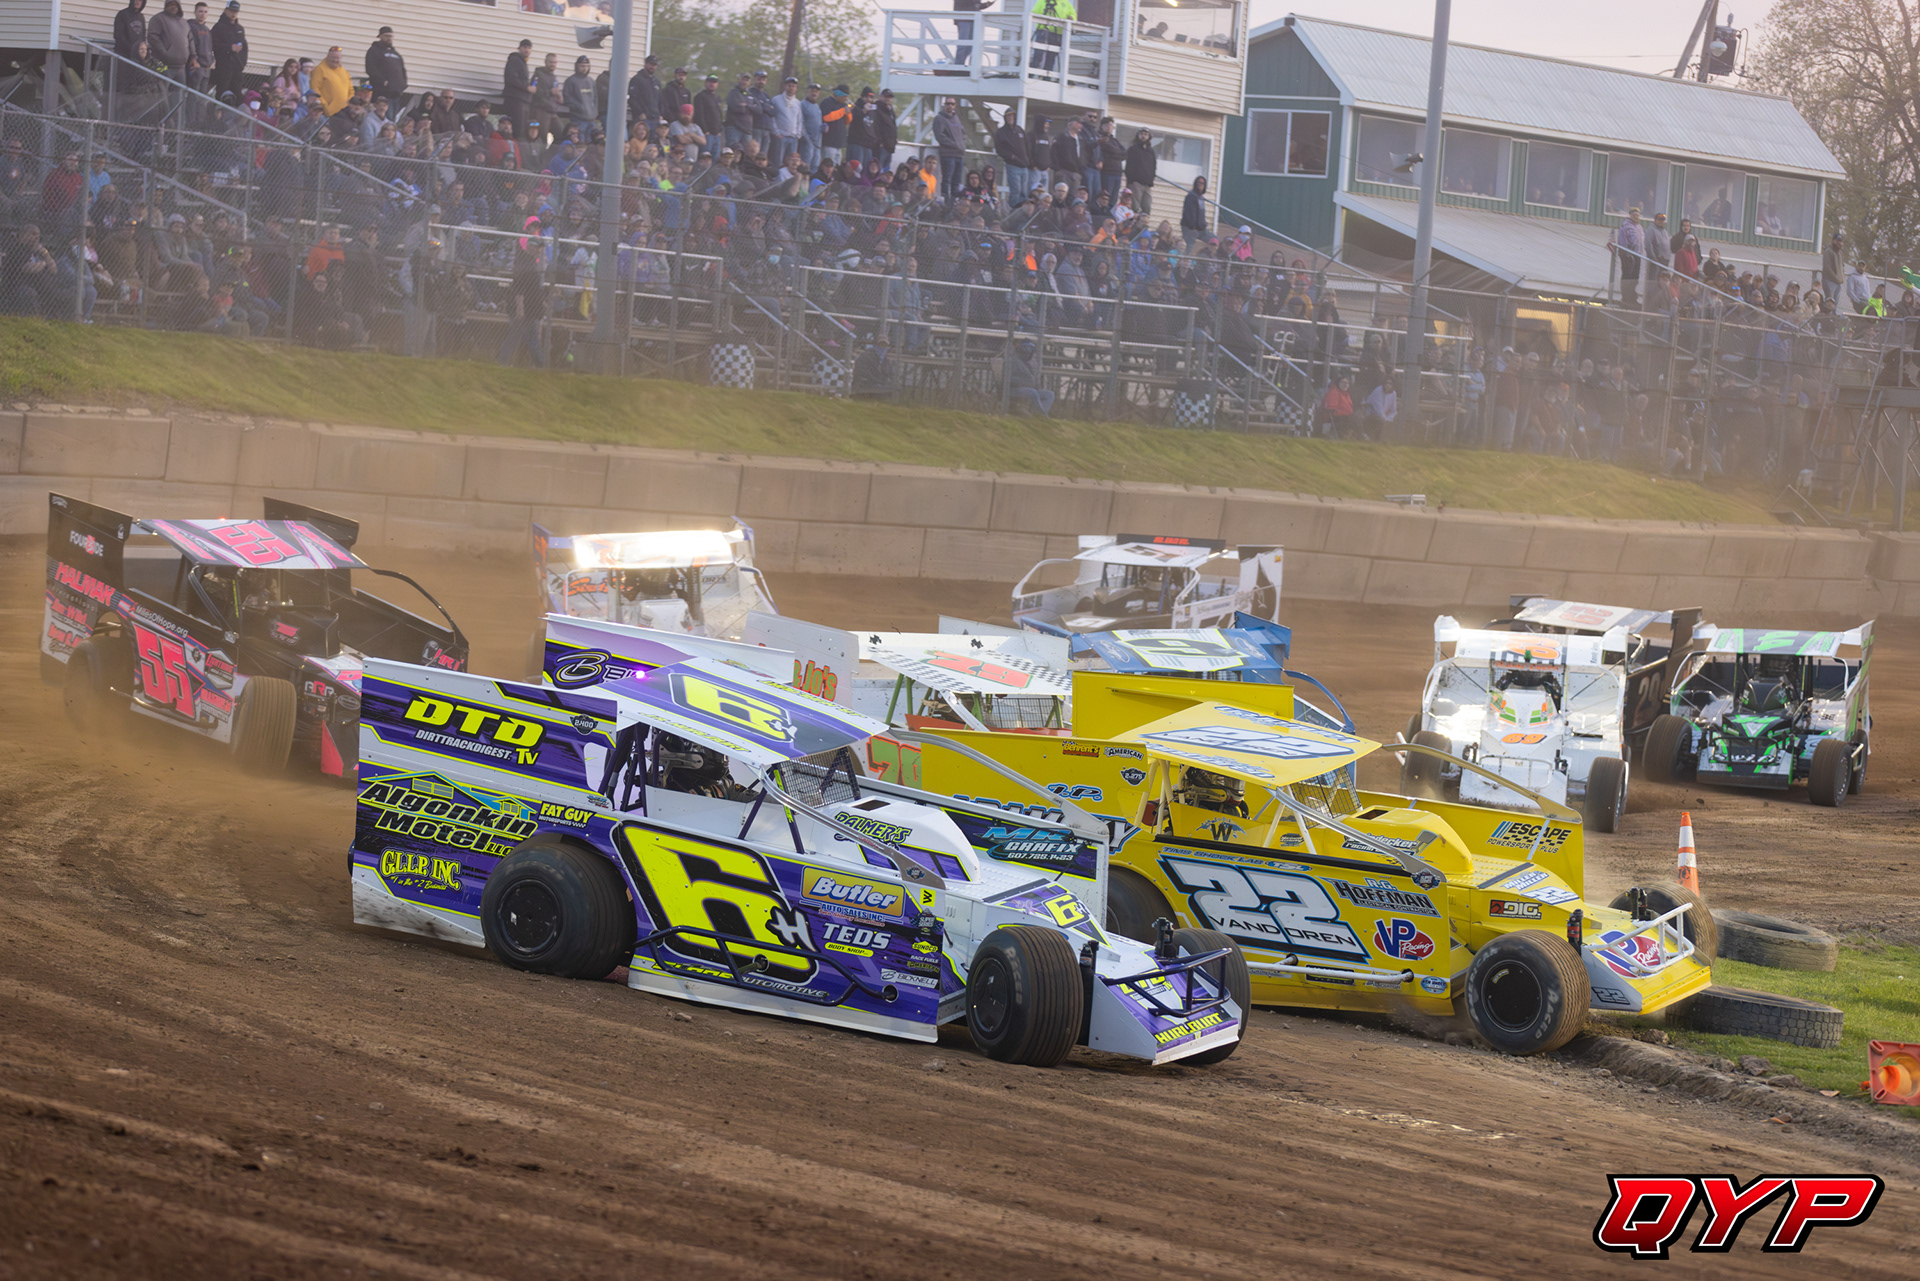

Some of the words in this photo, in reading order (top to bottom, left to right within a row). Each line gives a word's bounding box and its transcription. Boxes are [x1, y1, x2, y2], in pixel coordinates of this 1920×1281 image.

[207, 519, 303, 566] 55
[132, 620, 197, 720] 55
[404, 694, 544, 748] DTD
[1501, 732, 1548, 744] 69
[1107, 746, 1143, 761] AMERICAN
[358, 783, 539, 840] Algonkin
[540, 802, 564, 818] FAT
[564, 807, 593, 824] GUY
[375, 809, 488, 853] Motel
[1508, 822, 1572, 841] ESCAPE
[1003, 840, 1081, 854] GRAFIX
[1486, 838, 1539, 850] POWERSPORT
[1539, 845, 1559, 854] PLUS
[1238, 856, 1265, 865] LAB
[1366, 879, 1398, 891] R.G.
[1503, 872, 1537, 889] MILLER
[1515, 873, 1550, 890] MILLER
[810, 876, 899, 909] Butler
[1333, 880, 1434, 911] HOFFMAN
[821, 903, 842, 914] AUTO
[844, 906, 868, 918] SALES
[1158, 852, 1374, 963] 22
[821, 922, 892, 951] TED'S
[1374, 917, 1418, 958] VP
[1401, 938, 1435, 956] Racing
[912, 942, 938, 953] SUNOCO
[896, 973, 936, 987] BICKNELL
[1591, 986, 1631, 1006] 22
[1154, 1012, 1223, 1044] HURLBURT
